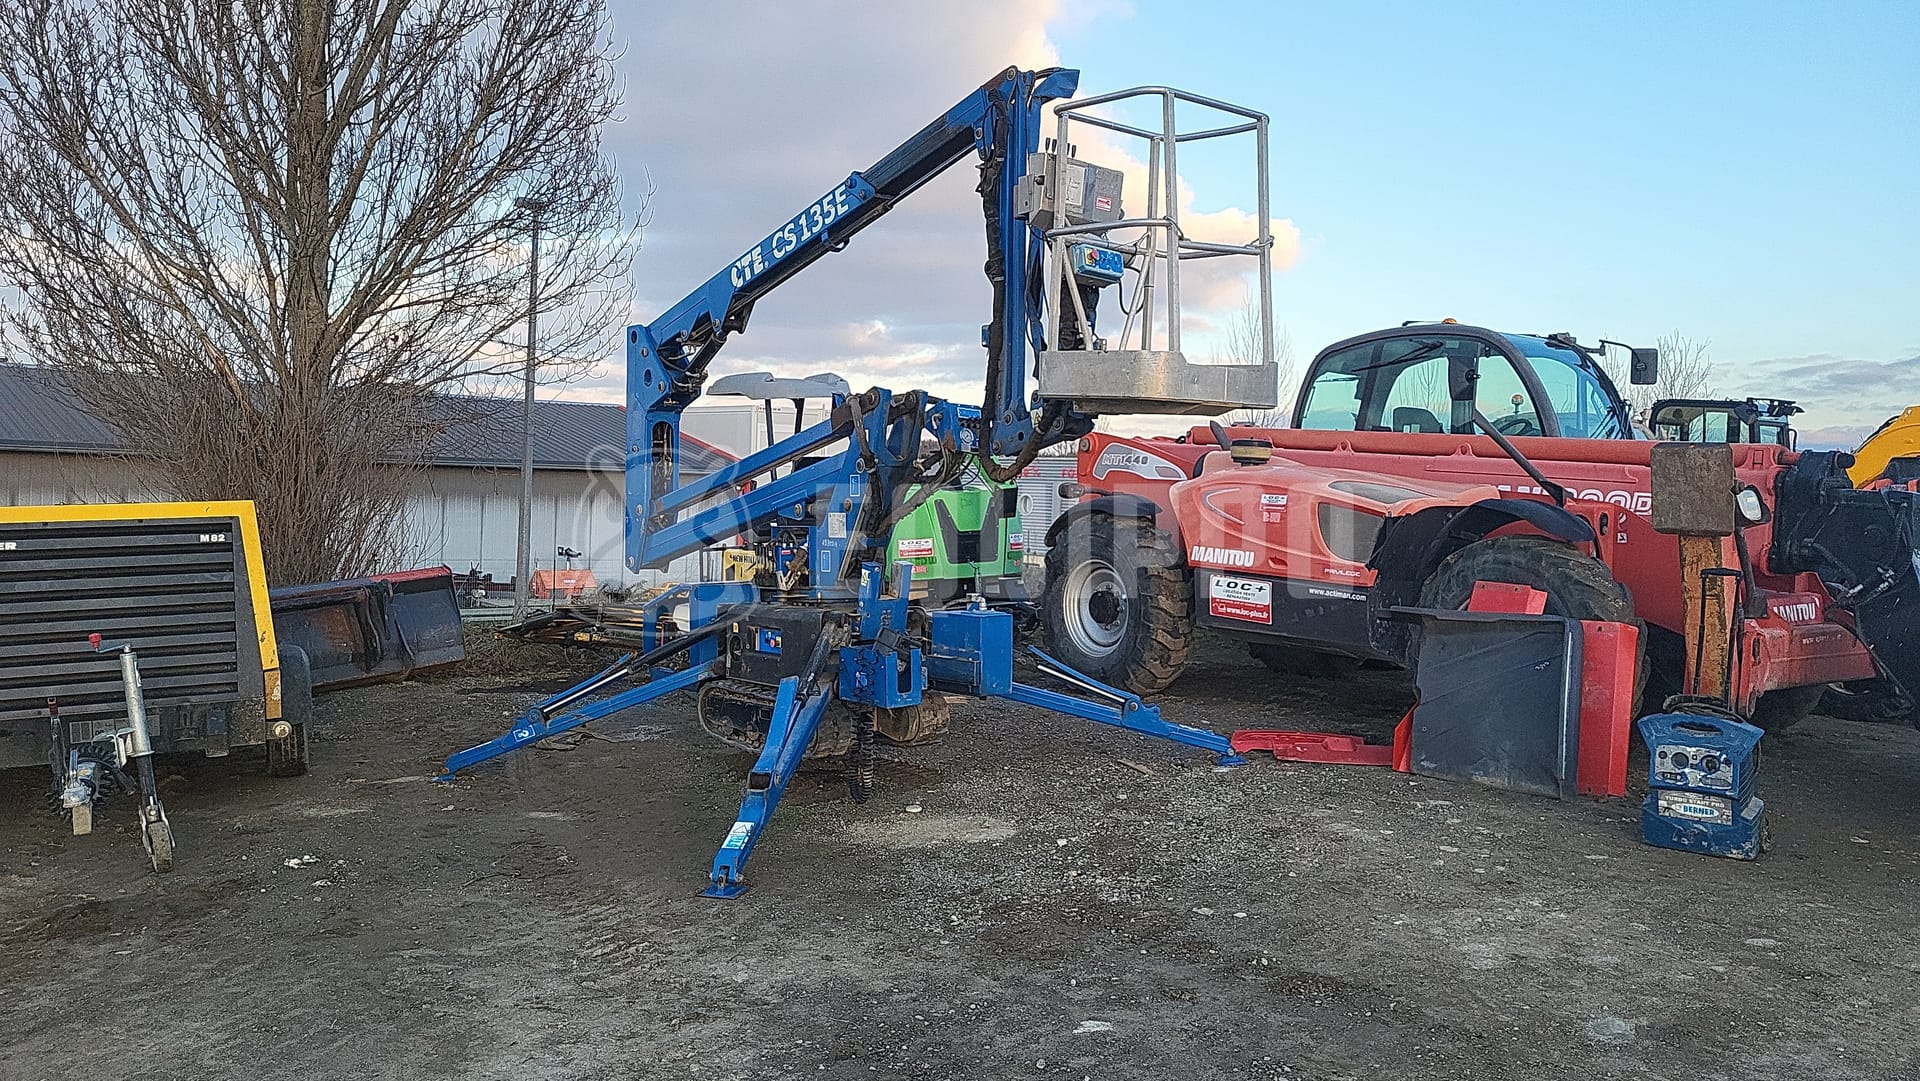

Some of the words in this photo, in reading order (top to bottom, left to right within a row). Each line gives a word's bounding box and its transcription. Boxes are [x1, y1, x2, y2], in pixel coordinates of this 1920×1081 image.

[731, 246, 764, 288] CTE
[1191, 545, 1255, 567] MANITOU
[1214, 579, 1267, 593] LOC+
[1308, 588, 1367, 601] www.actiman.com
[1226, 606, 1268, 618] www.loc-plus.fr
[1683, 805, 1715, 816] BERNER
